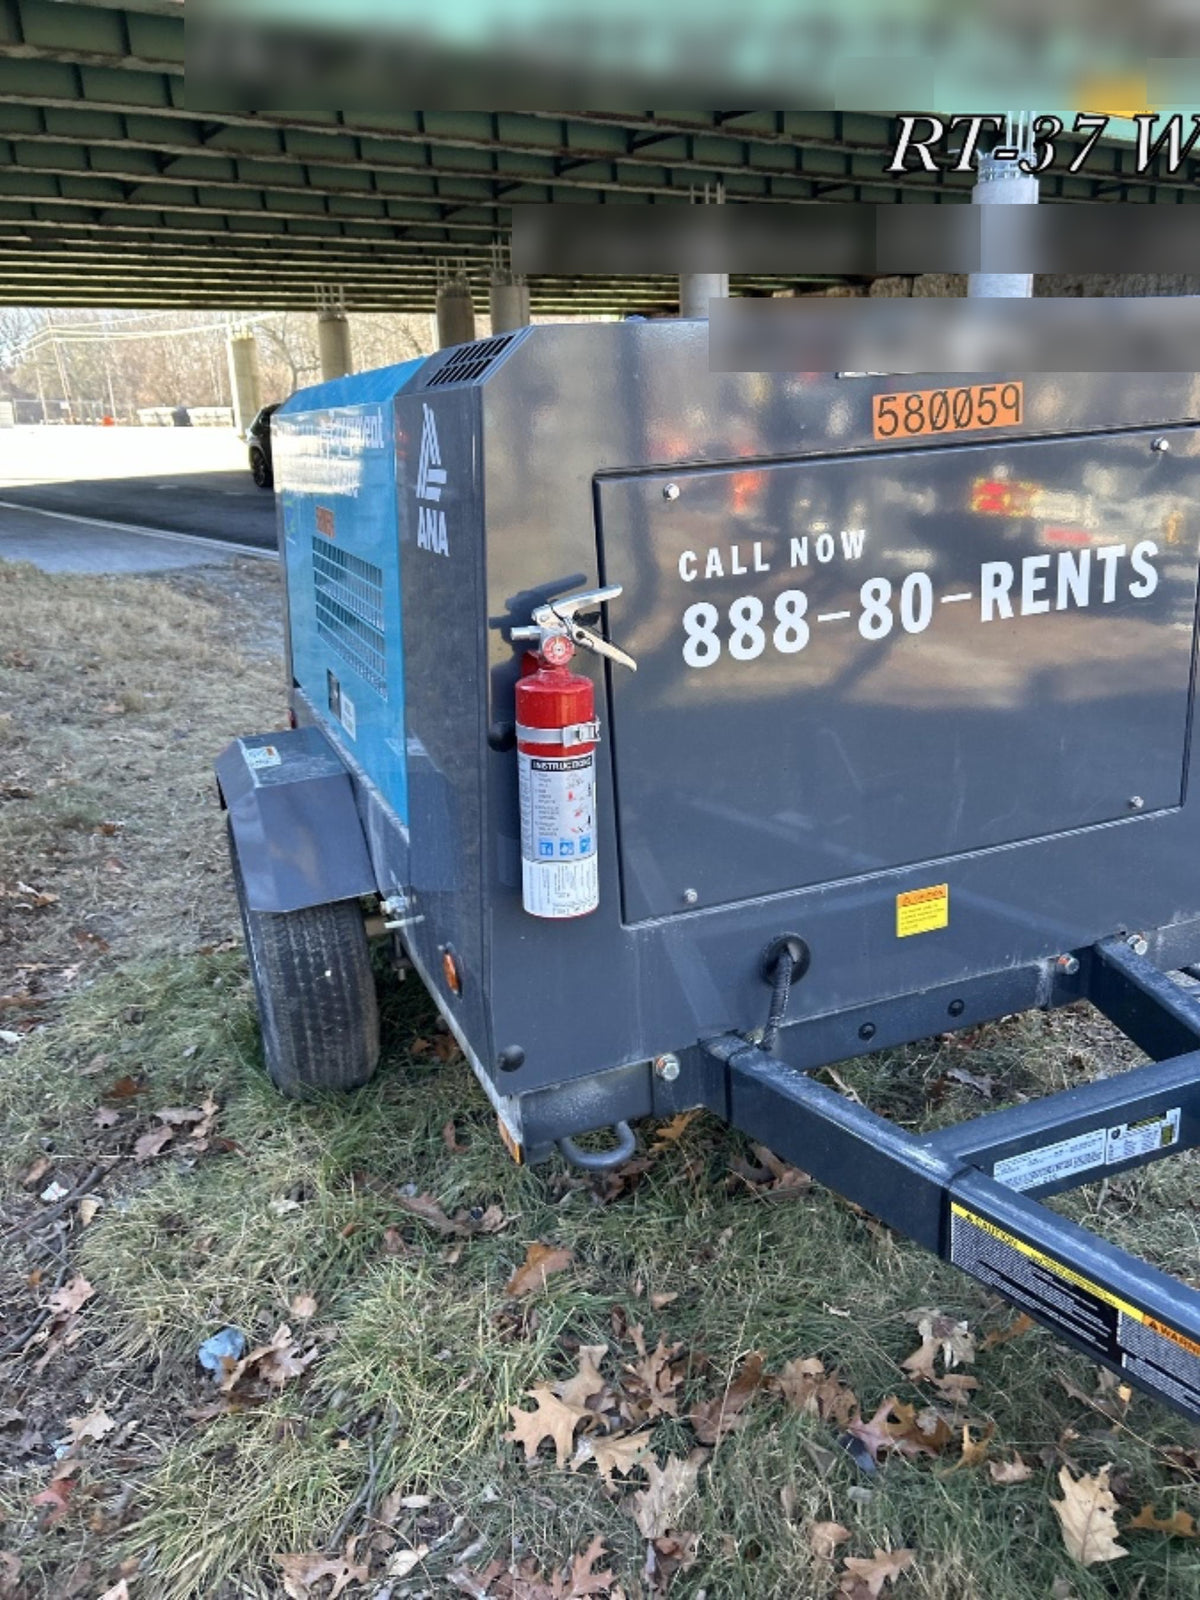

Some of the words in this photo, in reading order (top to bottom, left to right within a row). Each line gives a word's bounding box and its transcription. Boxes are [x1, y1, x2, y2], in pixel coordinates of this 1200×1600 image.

[878, 384, 1020, 436] 580059
[417, 506, 449, 557] ANA
[678, 542, 770, 582] CALL
[790, 529, 866, 567] NOW
